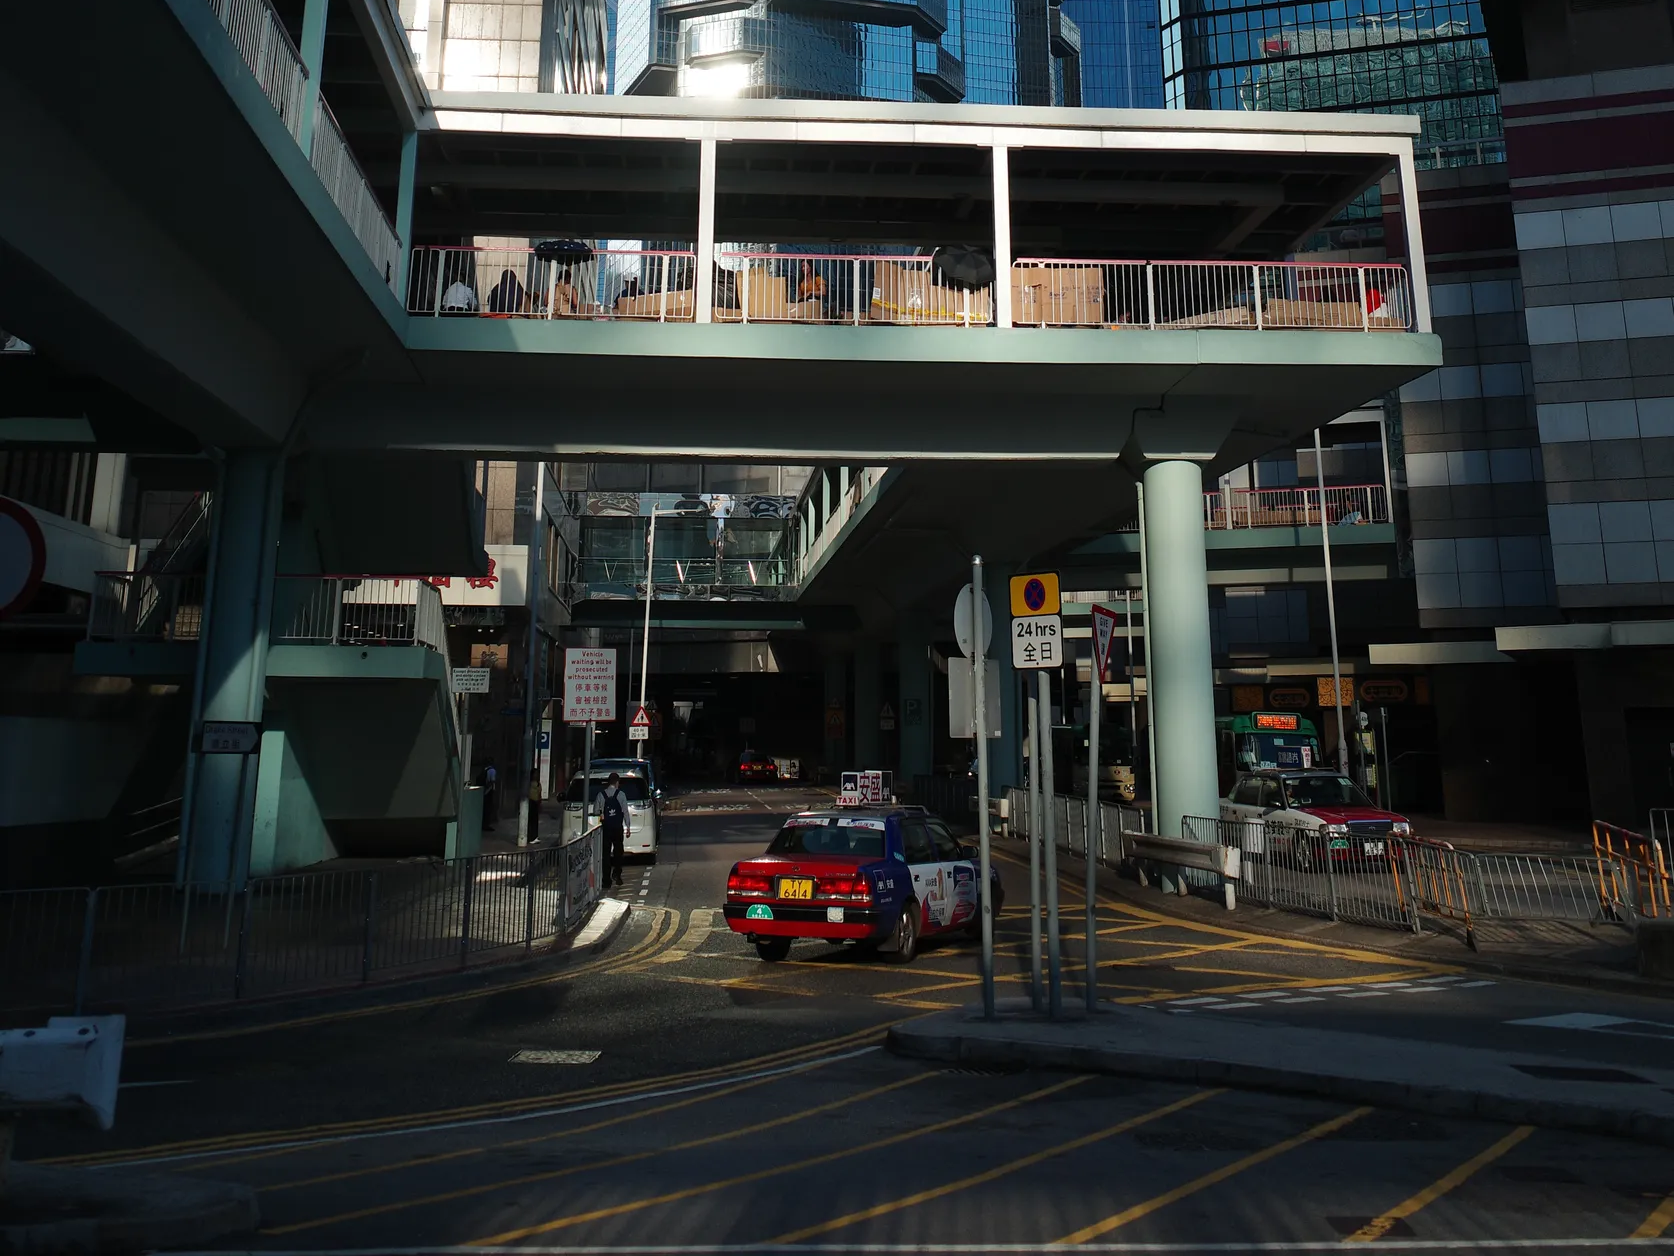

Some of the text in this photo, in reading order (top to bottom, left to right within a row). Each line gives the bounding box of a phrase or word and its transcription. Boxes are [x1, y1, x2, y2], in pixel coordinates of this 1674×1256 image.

[1017, 622, 1056, 637] 24 hrs
[1023, 642, 1052, 662] 全日
[575, 683, 608, 692] 停車等候
[860, 772, 881, 802] 安盛
[790, 880, 802, 889] TY
